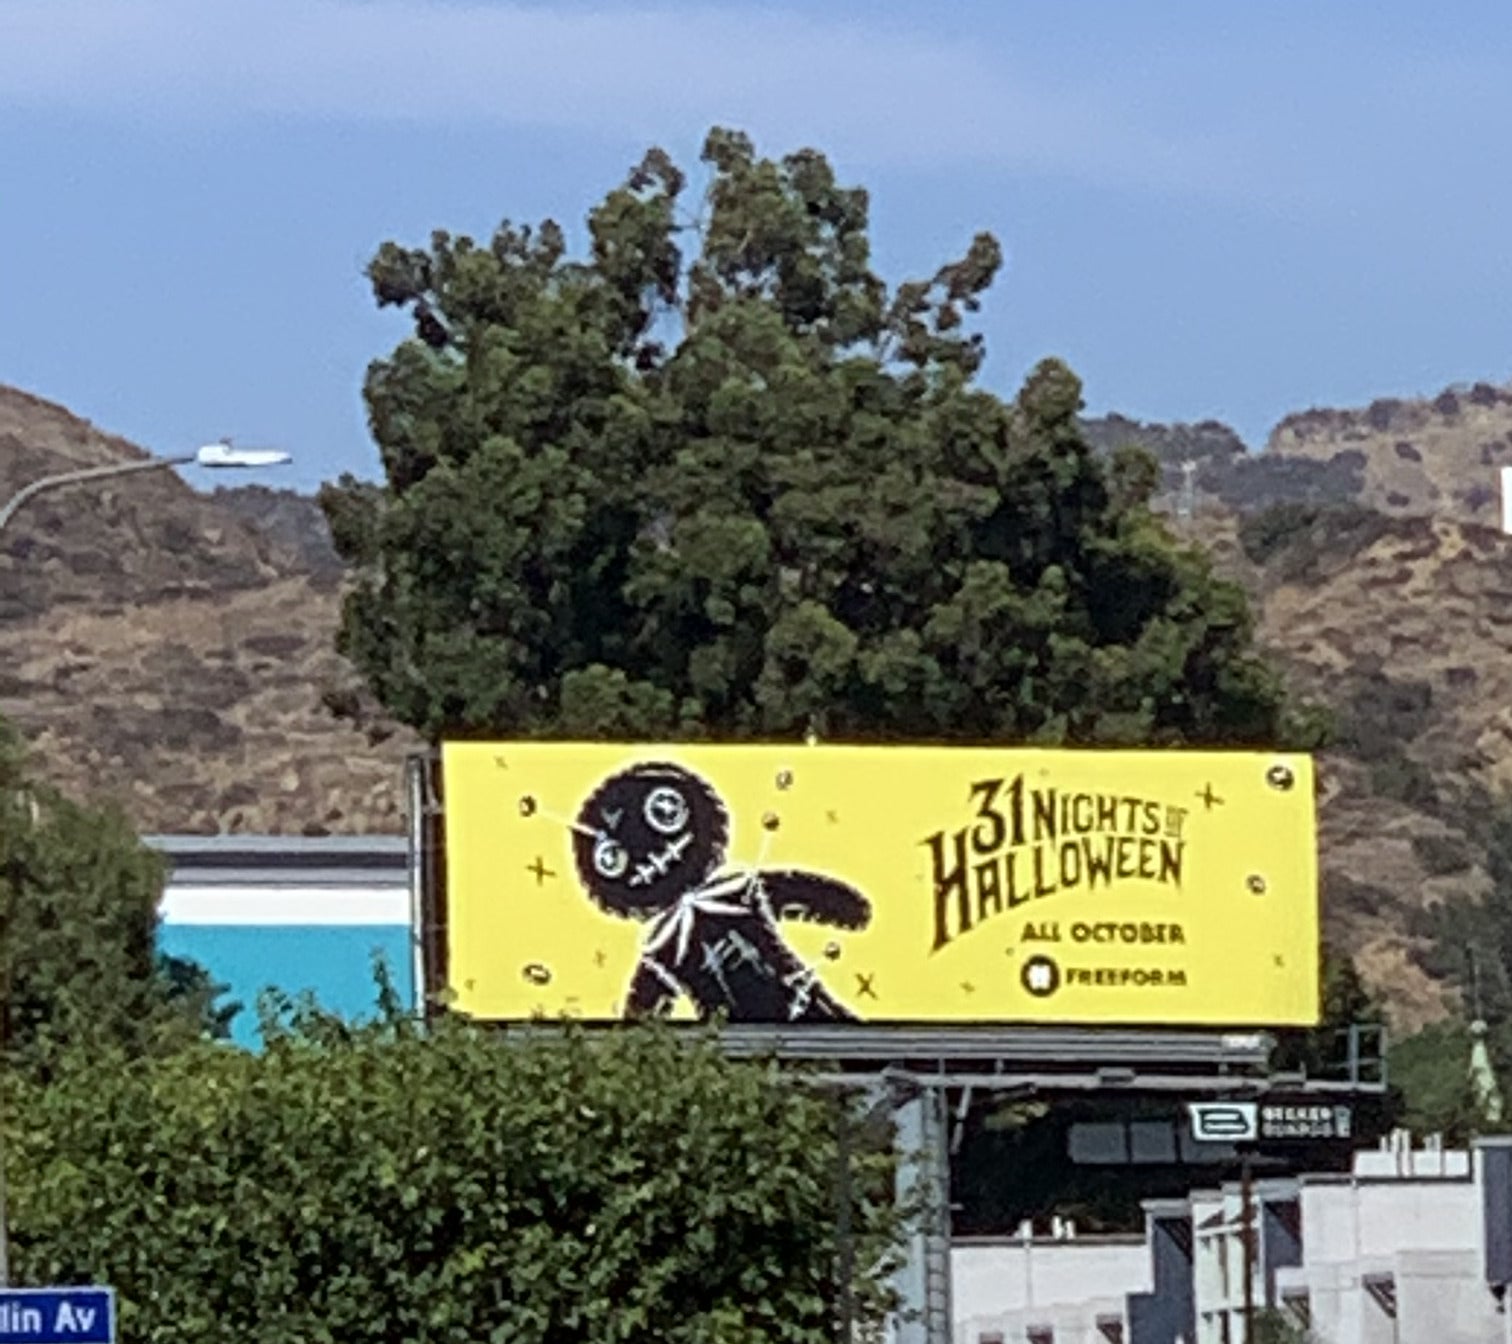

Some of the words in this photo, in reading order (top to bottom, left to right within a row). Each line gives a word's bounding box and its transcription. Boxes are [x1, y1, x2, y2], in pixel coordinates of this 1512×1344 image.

[968, 773, 1025, 855] 31
[1030, 787, 1162, 846] NIGHTS
[916, 824, 1187, 956] HALLOWEEN
[1020, 921, 1061, 944] ALL
[1070, 921, 1186, 944] OCTOBER
[1066, 967, 1187, 987] FREEFORM
[54, 1300, 96, 1333] Av
